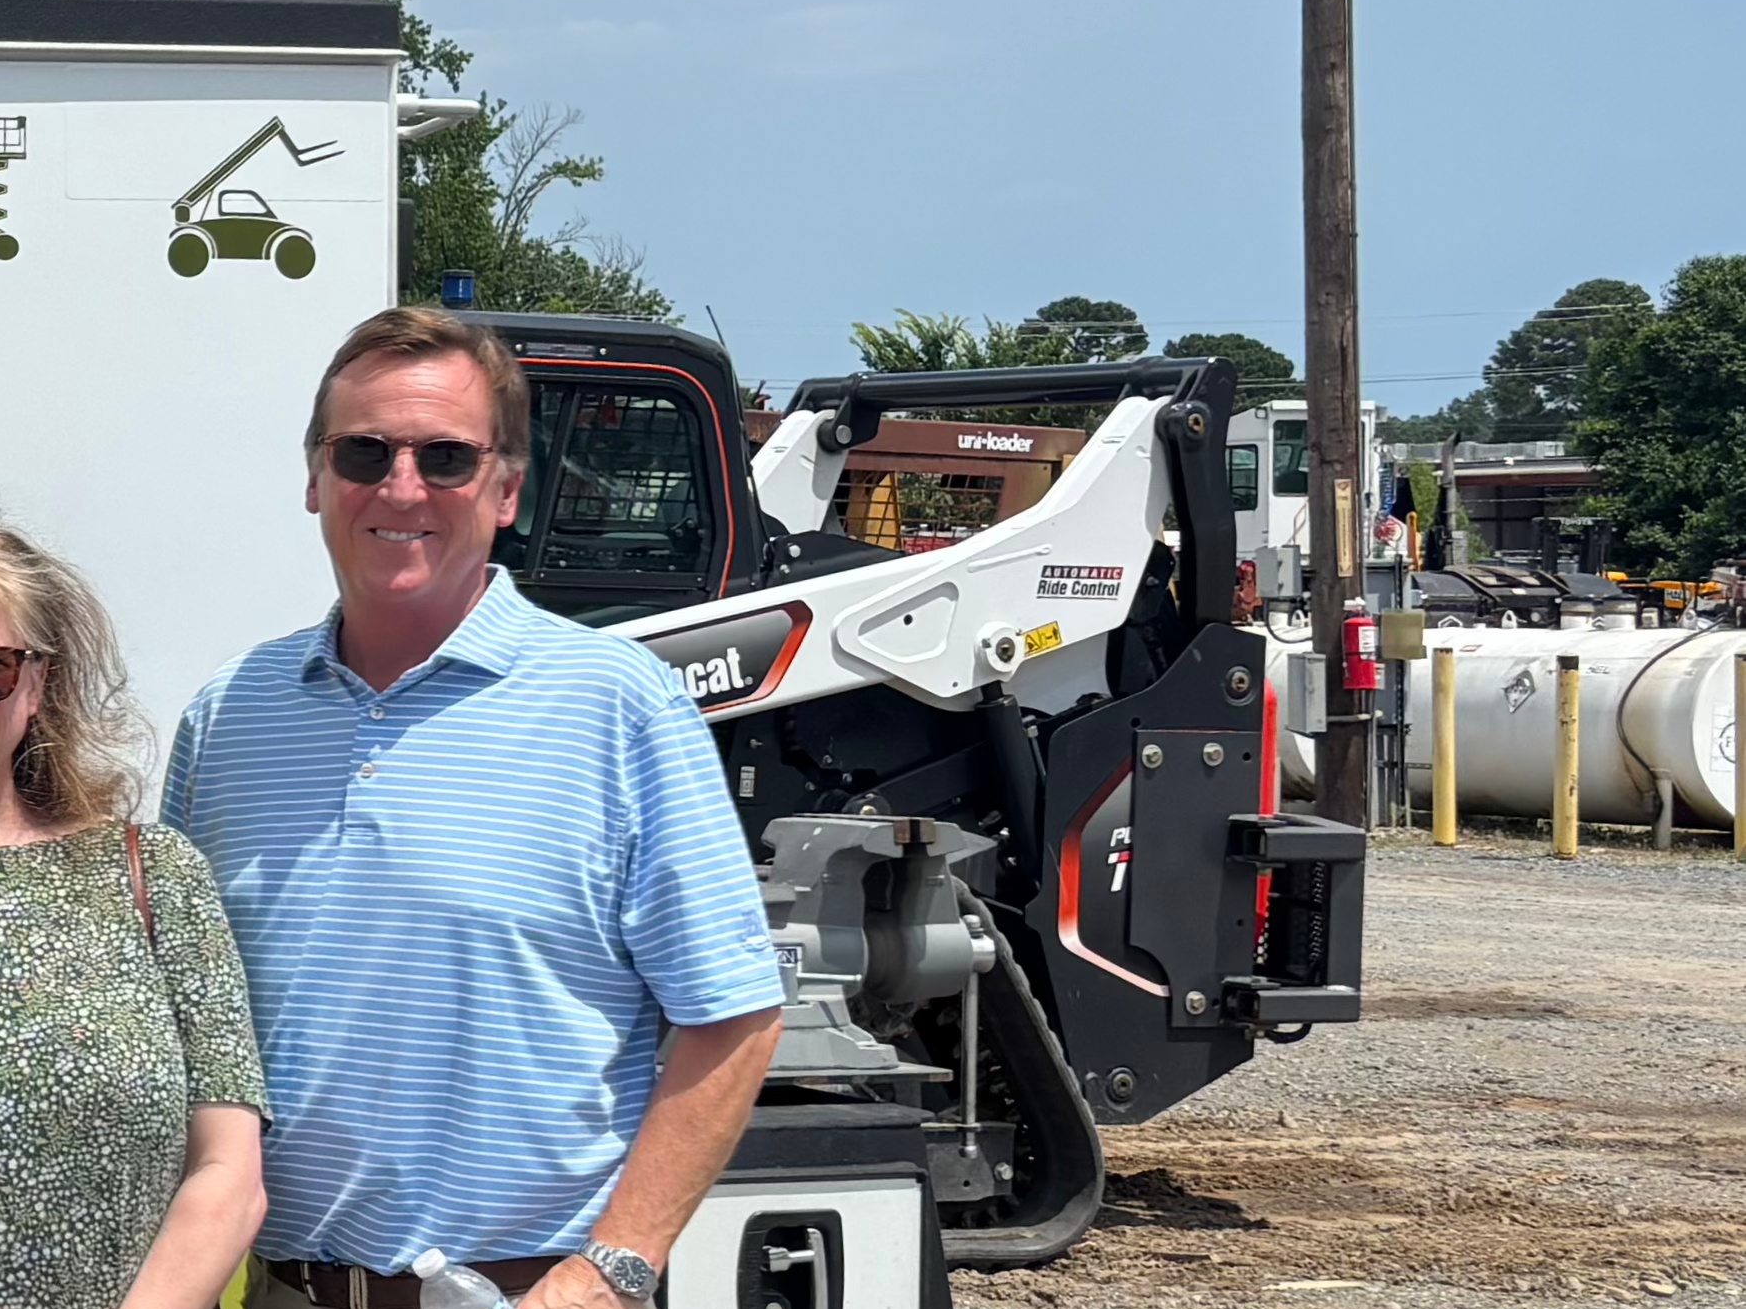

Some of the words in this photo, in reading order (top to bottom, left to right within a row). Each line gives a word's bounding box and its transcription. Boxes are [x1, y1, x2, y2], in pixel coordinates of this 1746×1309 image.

[1044, 567, 1122, 579] AUTOMATIC
[1037, 580, 1068, 595] Ride
[1071, 580, 1121, 596] Control
